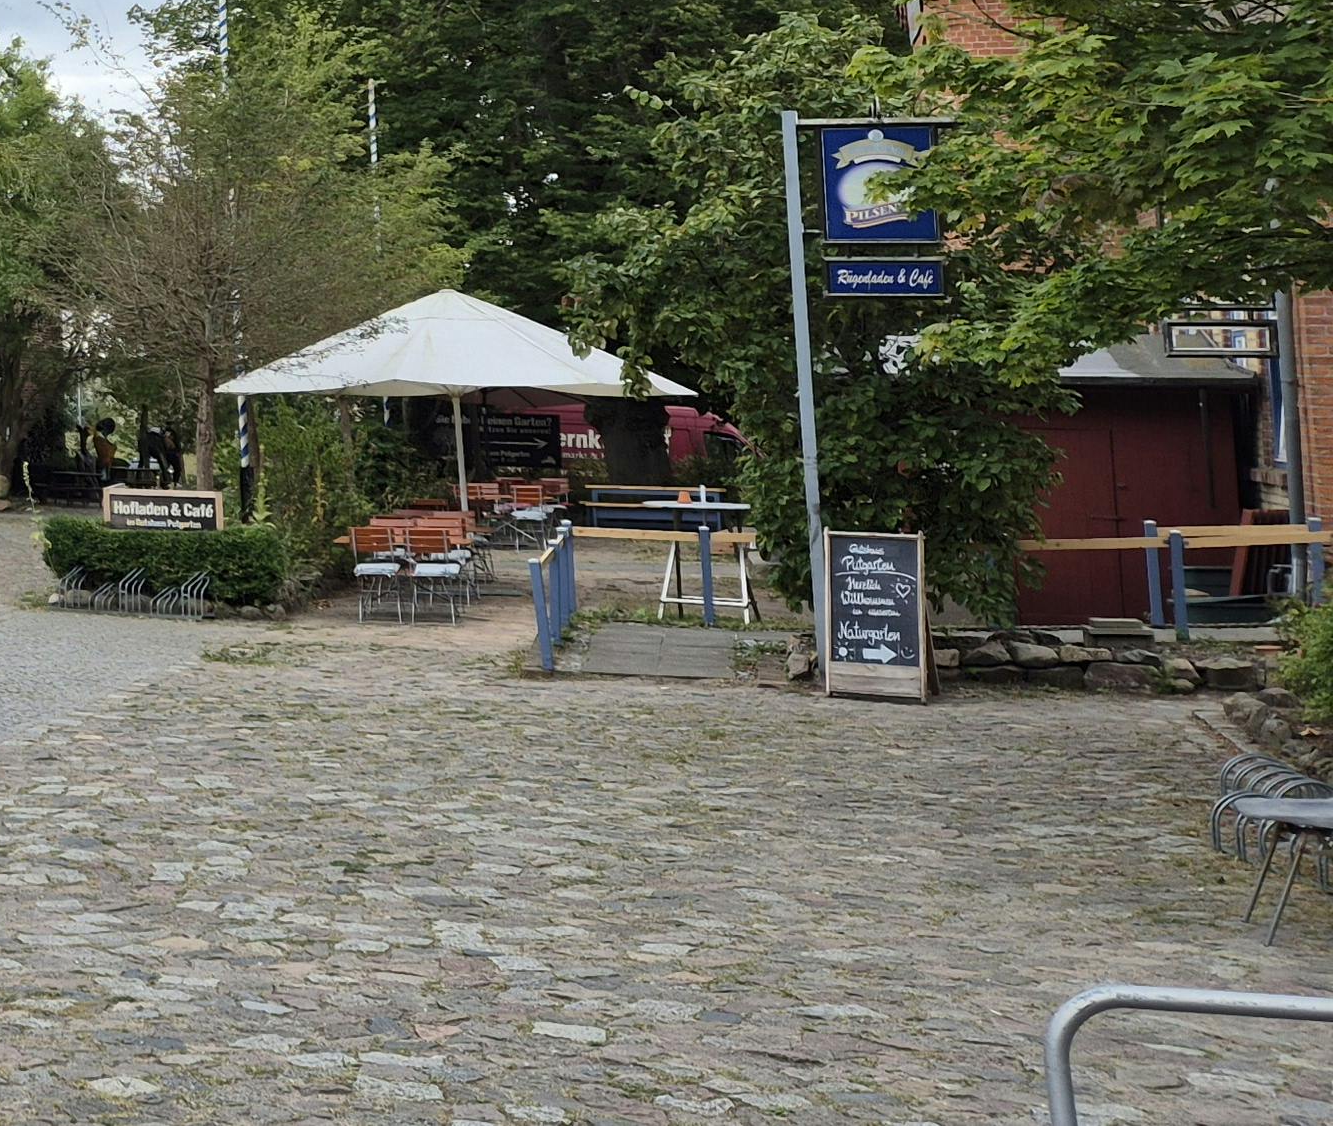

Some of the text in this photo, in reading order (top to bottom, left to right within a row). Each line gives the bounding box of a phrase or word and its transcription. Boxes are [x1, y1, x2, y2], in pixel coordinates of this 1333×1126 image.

[844, 202, 902, 223] PILSEN
[897, 268, 906, 284] &
[909, 268, 934, 289] Café
[112, 500, 214, 518] Hofladen & Café
[841, 555, 895, 576] Putgarten
[837, 620, 901, 646] Naturgarten
